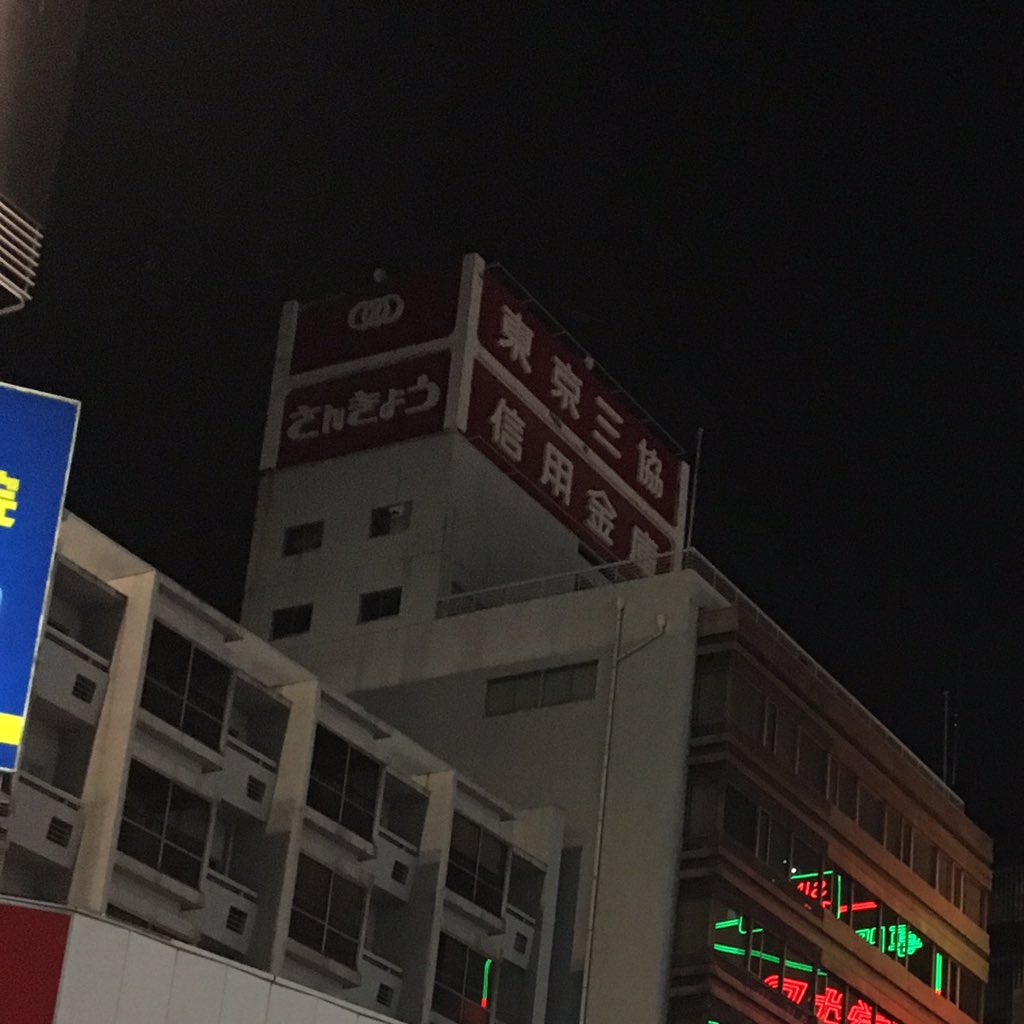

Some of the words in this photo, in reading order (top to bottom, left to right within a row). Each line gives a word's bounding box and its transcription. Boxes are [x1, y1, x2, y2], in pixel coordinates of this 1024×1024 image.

[287, 373, 442, 441] さんきょう
[497, 305, 664, 499] 東京三協
